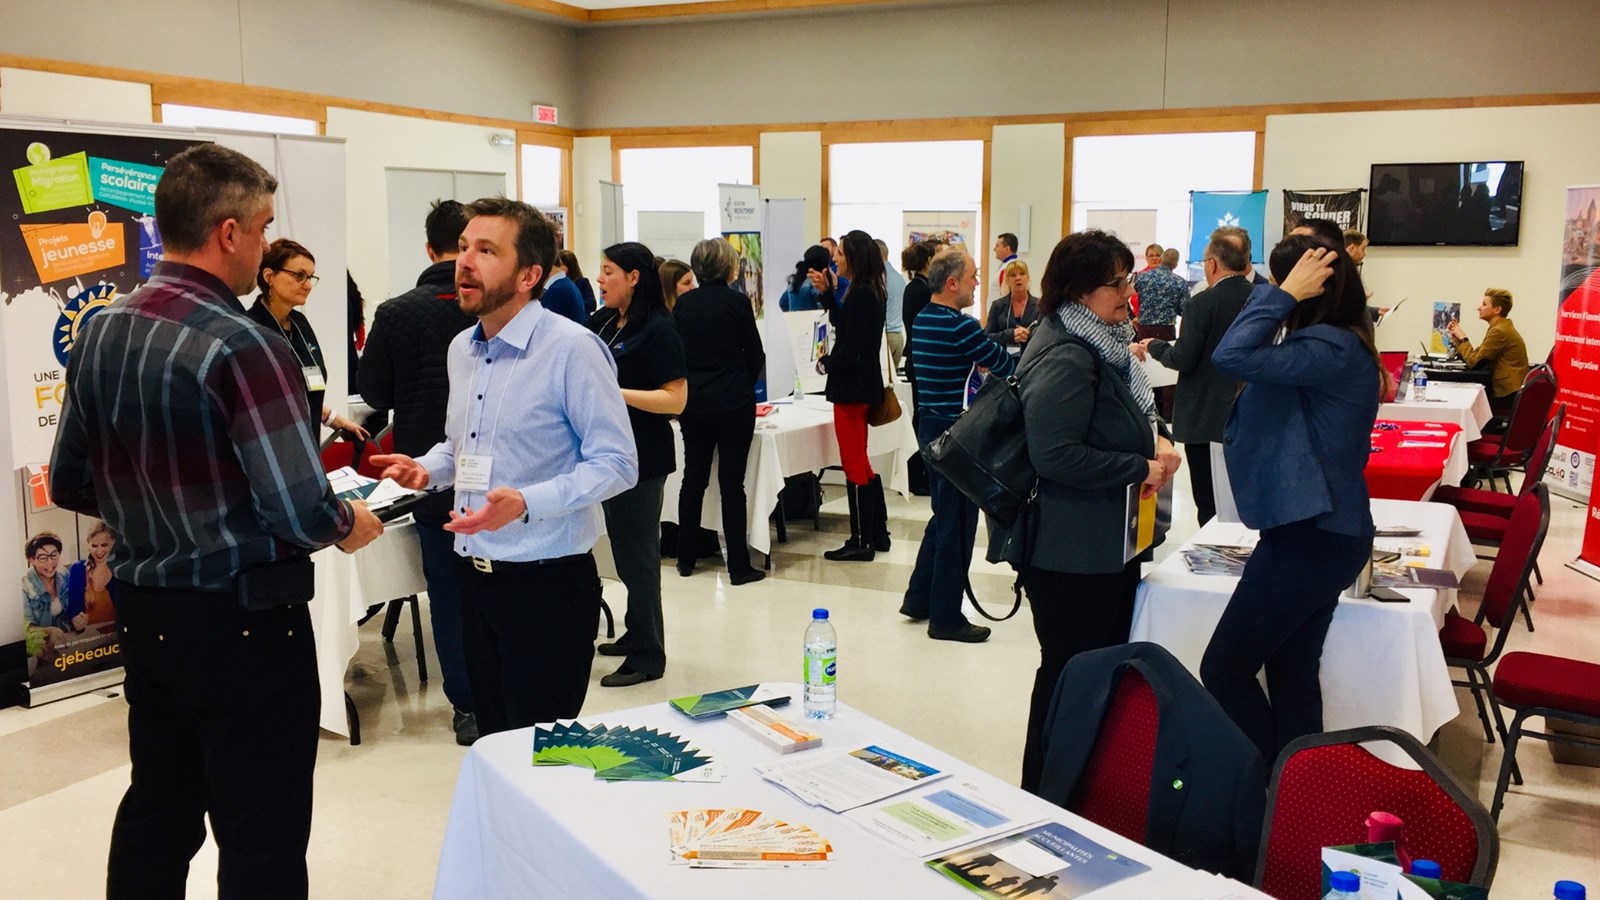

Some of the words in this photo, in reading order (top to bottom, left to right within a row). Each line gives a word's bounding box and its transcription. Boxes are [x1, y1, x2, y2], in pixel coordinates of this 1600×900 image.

[538, 107, 556, 122] SORTIE
[101, 162, 157, 181] Persévérance
[101, 174, 157, 193] scolaire
[1291, 202, 1315, 212] VIENS
[1316, 203, 1326, 212] TE
[38, 235, 69, 247] Projets
[41, 238, 116, 269] jeunesse
[34, 370, 60, 382] UNE
[38, 414, 57, 427] DE
[54, 644, 120, 672] cjebeauc
[1032, 833, 1089, 864] ACCUEILLANTES
[1041, 829, 1095, 860] MUNICIPALITÉS
